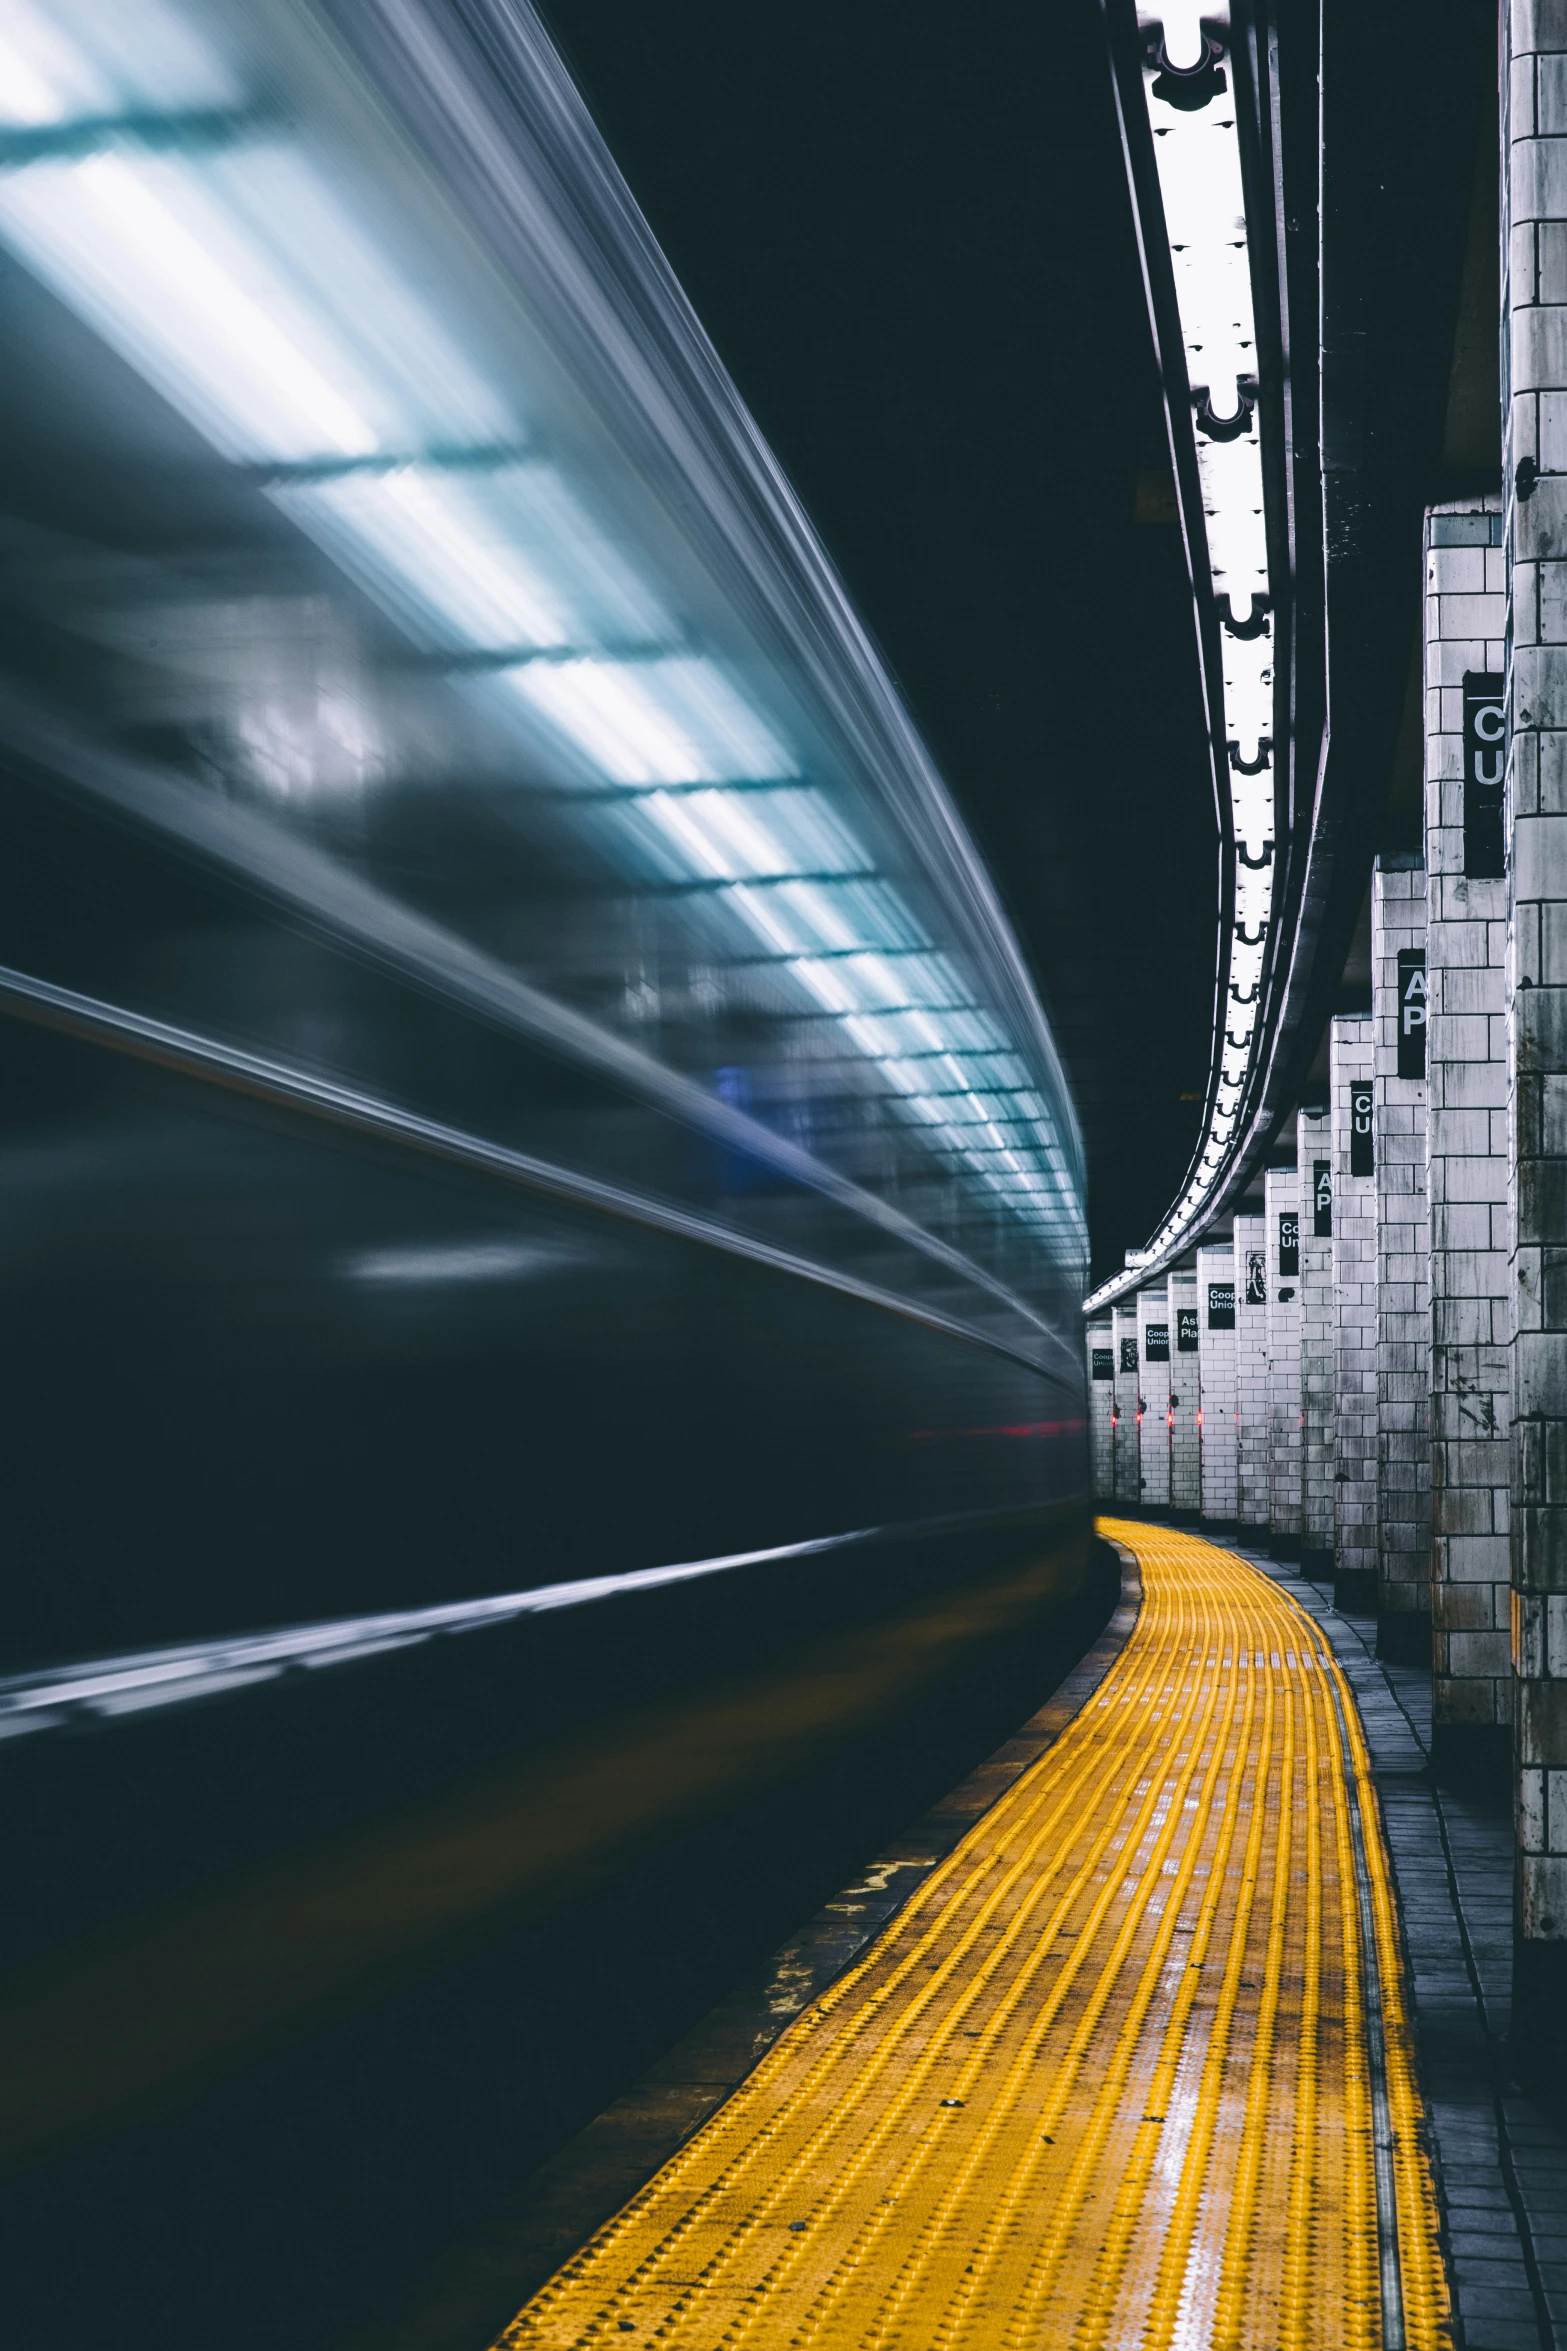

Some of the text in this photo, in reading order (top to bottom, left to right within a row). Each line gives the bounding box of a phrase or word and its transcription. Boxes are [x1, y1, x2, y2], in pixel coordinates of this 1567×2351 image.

[1474, 751, 1504, 785] U
[1404, 970, 1427, 1000] A
[1403, 1006, 1427, 1035] P
[1355, 1116, 1370, 1133] U
[1317, 1172, 1332, 1190] A
[1317, 1193, 1332, 1211] P
[1210, 1300, 1236, 1309] Unio
